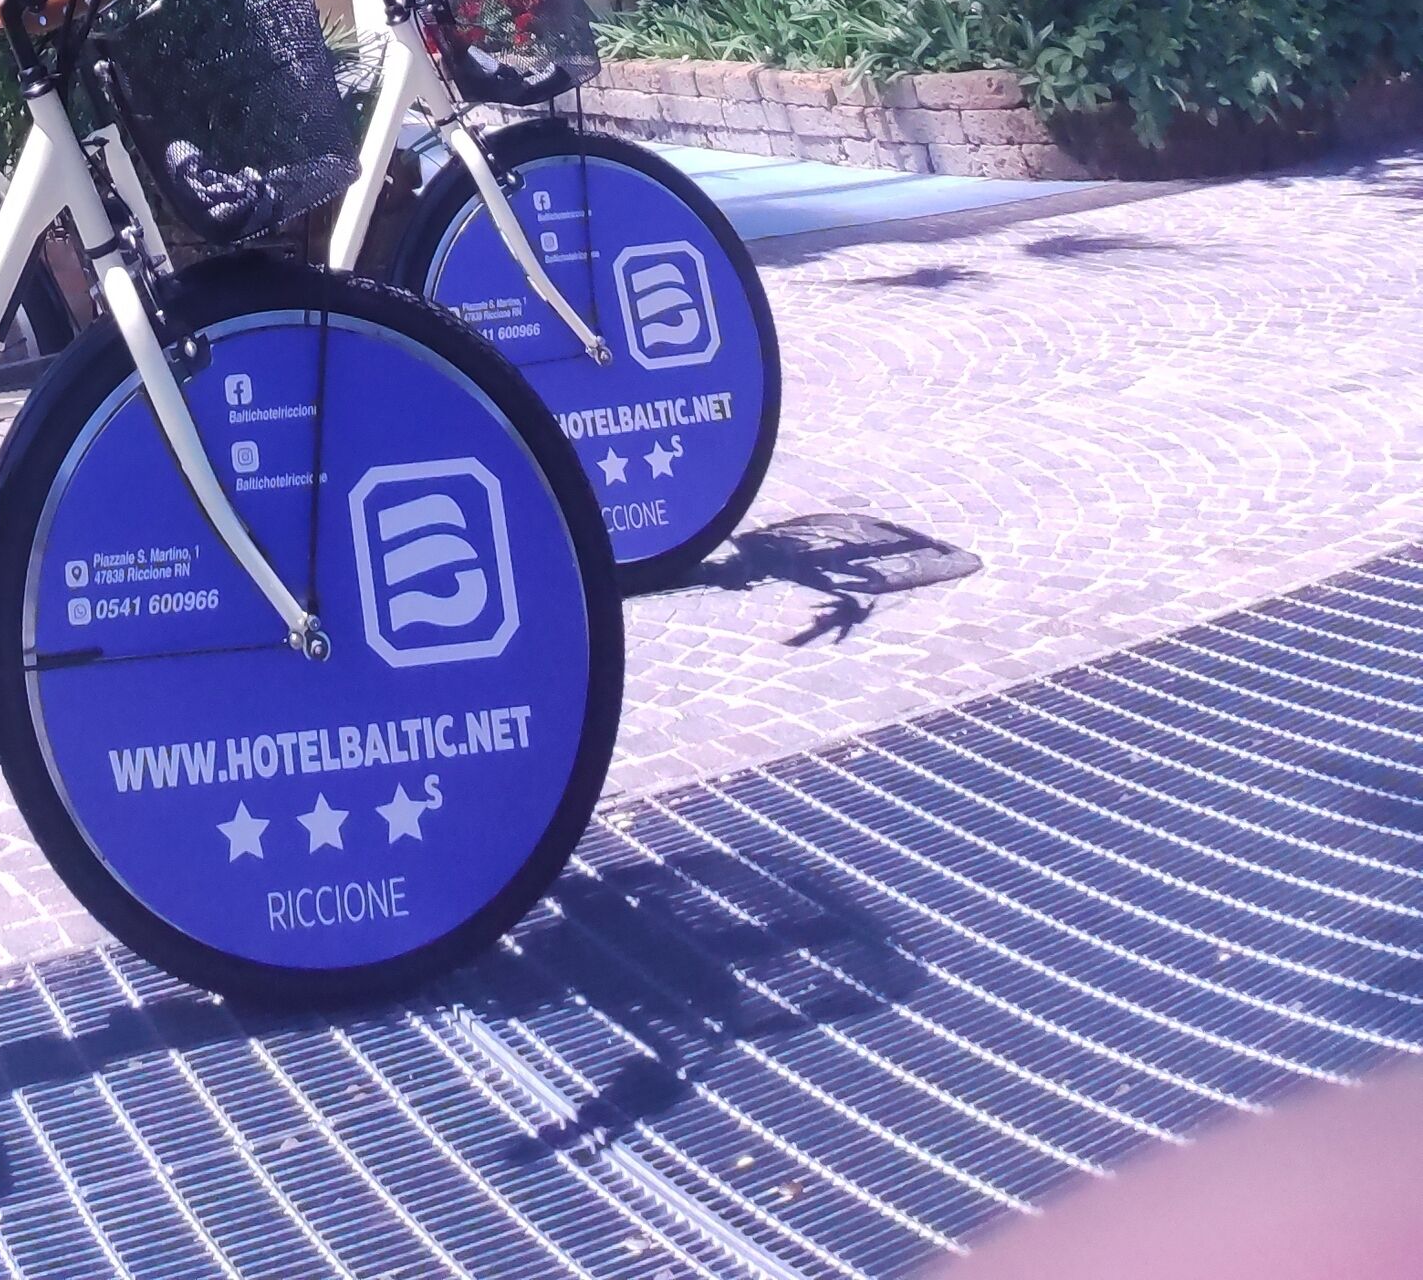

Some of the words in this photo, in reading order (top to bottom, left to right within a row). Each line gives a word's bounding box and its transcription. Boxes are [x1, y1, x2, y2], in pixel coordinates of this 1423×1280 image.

[498, 323, 541, 340] 600966
[229, 403, 317, 424] Baltichotelriccion
[554, 392, 732, 439] HOTELBALTIC.NET
[670, 434, 684, 458] S
[602, 499, 669, 533] CCIONE
[93, 550, 135, 569] Piazzale
[137, 548, 148, 565] S.
[150, 545, 192, 563] Martino,
[194, 544, 200, 560] 1
[127, 564, 172, 582] Riccione
[174, 562, 191, 578] RN
[96, 596, 142, 620] 0541
[148, 589, 220, 615] 600966
[108, 705, 532, 793] WWW.HOTELBALTIC.NET
[424, 774, 443, 810] S
[266, 876, 410, 932] RICCIONE
